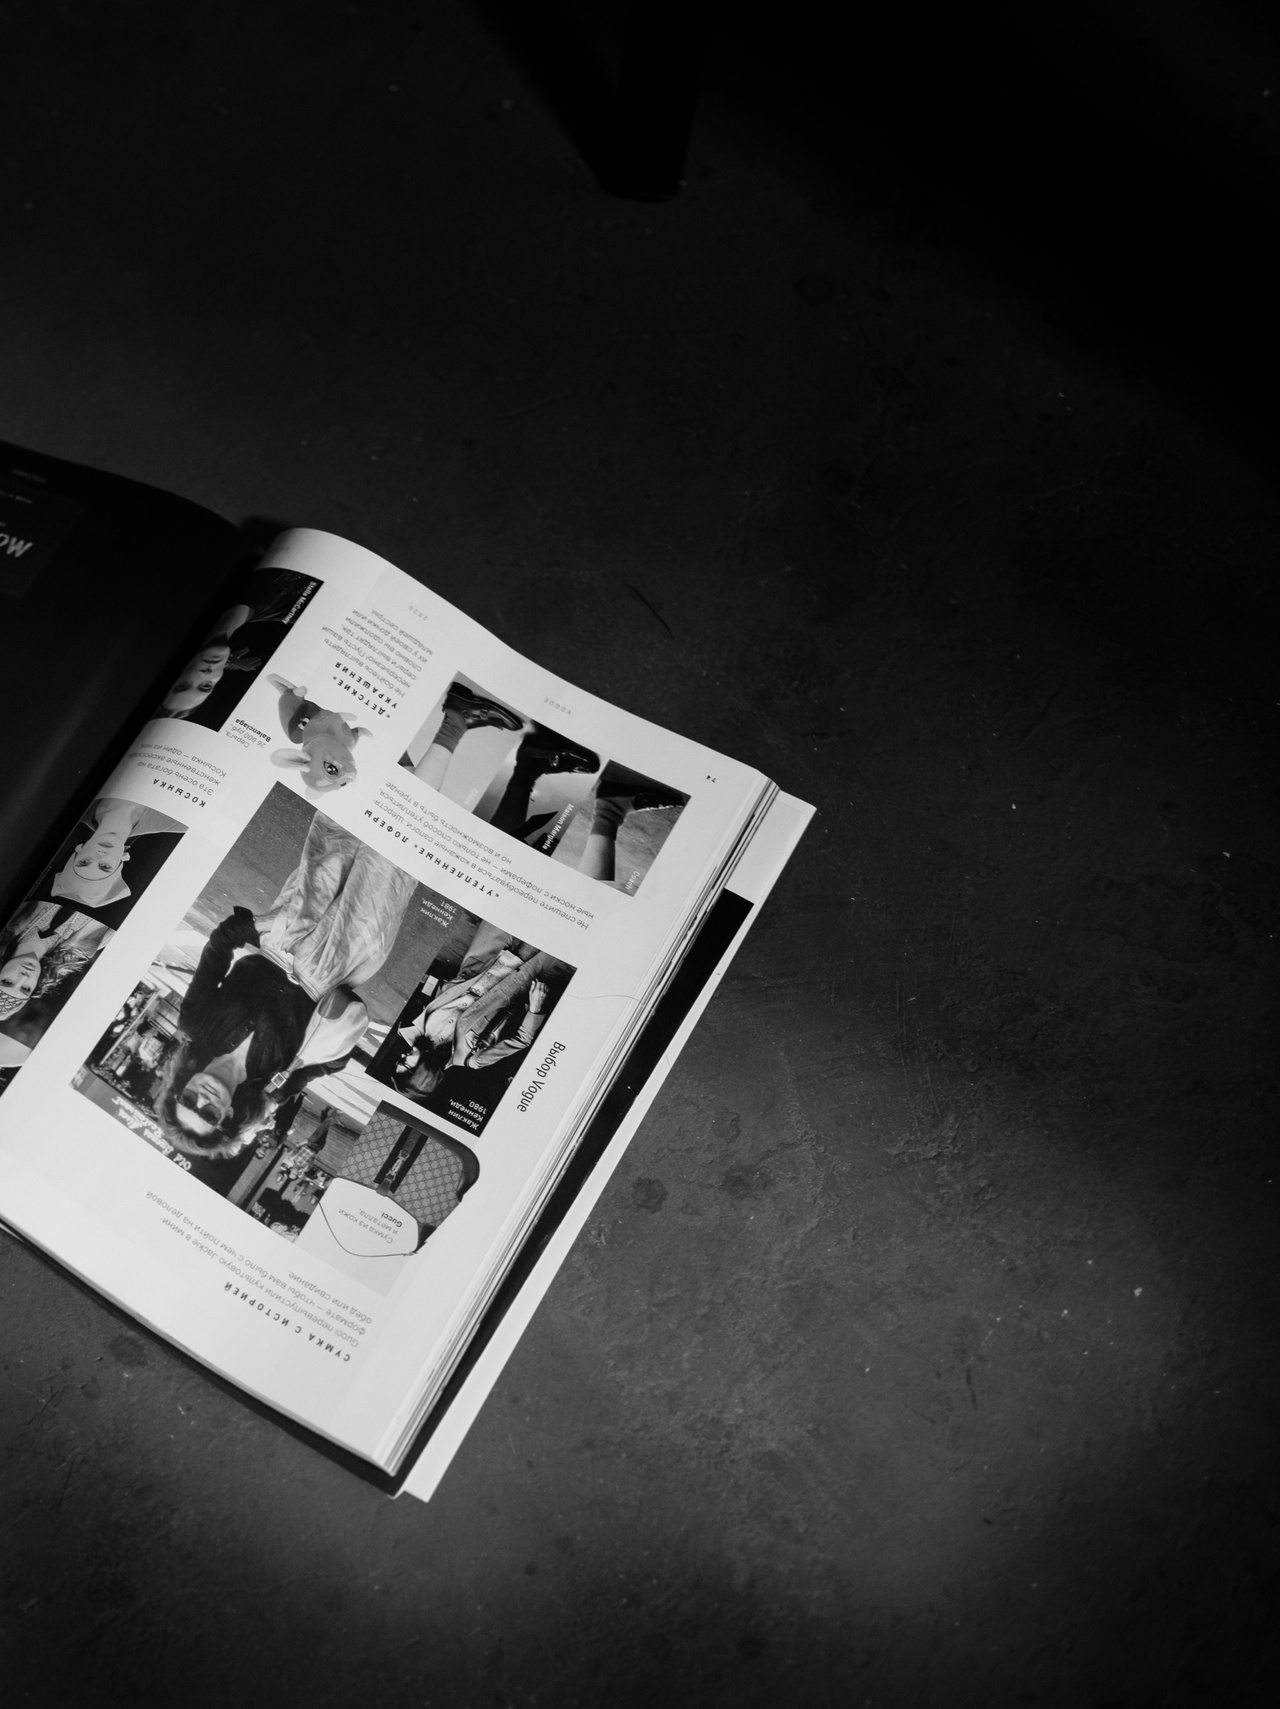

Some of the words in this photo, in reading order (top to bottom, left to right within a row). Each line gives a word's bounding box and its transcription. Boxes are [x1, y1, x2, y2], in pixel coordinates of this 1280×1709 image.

[301, 581, 317, 596] Stella
[281, 595, 306, 624] McCartney
[321, 624, 343, 641] ваши
[344, 616, 384, 645] одолжили
[366, 618, 391, 637] дочки
[322, 637, 364, 667] выглядеть
[341, 638, 366, 657] Пусть
[354, 634, 391, 662] выглядят
[382, 642, 395, 652] вы
[388, 634, 413, 653] своей
[397, 628, 433, 655] младшей
[390, 659, 417, 680] серьги
[393, 649, 422, 672] словно
[334, 660, 397, 708] УКРАШЕНИЯ
[362, 664, 394, 690] бойтесь
[330, 674, 391, 719] «ДЕТСКИЕ»
[393, 686, 405, 698] Не
[542, 696, 572, 715] VOGUE
[162, 745, 182, 756] один
[146, 762, 173, 776] богата
[165, 756, 220, 786] женственные
[190, 755, 226, 778] Косынка
[173, 770, 198, 787] осень
[197, 782, 214, 796] Эта
[151, 777, 206, 808] КОСЫНКА
[371, 797, 404, 823] Шерстя-
[417, 804, 439, 823] быть
[556, 802, 574, 825] Maison
[363, 808, 408, 843] ЛОФЕРЫ
[421, 819, 452, 842] способ
[438, 818, 494, 855] возможность
[541, 823, 561, 850] Margiela
[432, 839, 470, 866] кожаные
[451, 838, 480, 859] только
[480, 856, 491, 865] не
[500, 854, 512, 865] но
[412, 843, 499, 899] «УТЕПЛЕННЫЕ»
[499, 867, 543, 894] лоферами
[624, 870, 640, 889] Coach
[476, 865, 539, 904] переобуваться
[420, 896, 453, 920] Кеннеди,
[538, 900, 576, 923] спешите
[549, 893, 576, 911] носки
[419, 907, 449, 928] Жаклин
[576, 906, 594, 920] ные
[575, 919, 589, 930] Не
[534, 1040, 566, 1078] Выбор
[466, 1098, 487, 1115] 1980.
[516, 1080, 544, 1113] Vogue
[447, 1097, 483, 1122] Кеннеди,
[447, 1108, 479, 1130] Жаклин
[172, 1152, 193, 1171] Old
[144, 1190, 183, 1219] деловой
[158, 1215, 185, 1236] мини-
[182, 1216, 194, 1227] на
[337, 1208, 358, 1223] кожи
[358, 1219, 368, 1229] из
[380, 1211, 403, 1228] Gucci
[192, 1224, 220, 1247] пойти
[368, 1225, 394, 1244] Сумка
[190, 1237, 219, 1261] Jackie
[219, 1242, 238, 1257] чем
[217, 1256, 266, 1290] культовую
[243, 1258, 268, 1278] было
[268, 1273, 287, 1289] вам
[223, 1281, 289, 1326] ИСТОРИЕЙ
[286, 1285, 316, 1307] чтобы
[330, 1296, 349, 1311] или
[263, 1286, 335, 1333] перевыпустили
[348, 1306, 372, 1326] обед
[293, 1324, 302, 1334] С
[324, 1307, 367, 1337] формате
[306, 1332, 350, 1362] СУМКА
[332, 1327, 359, 1348] Gucci
